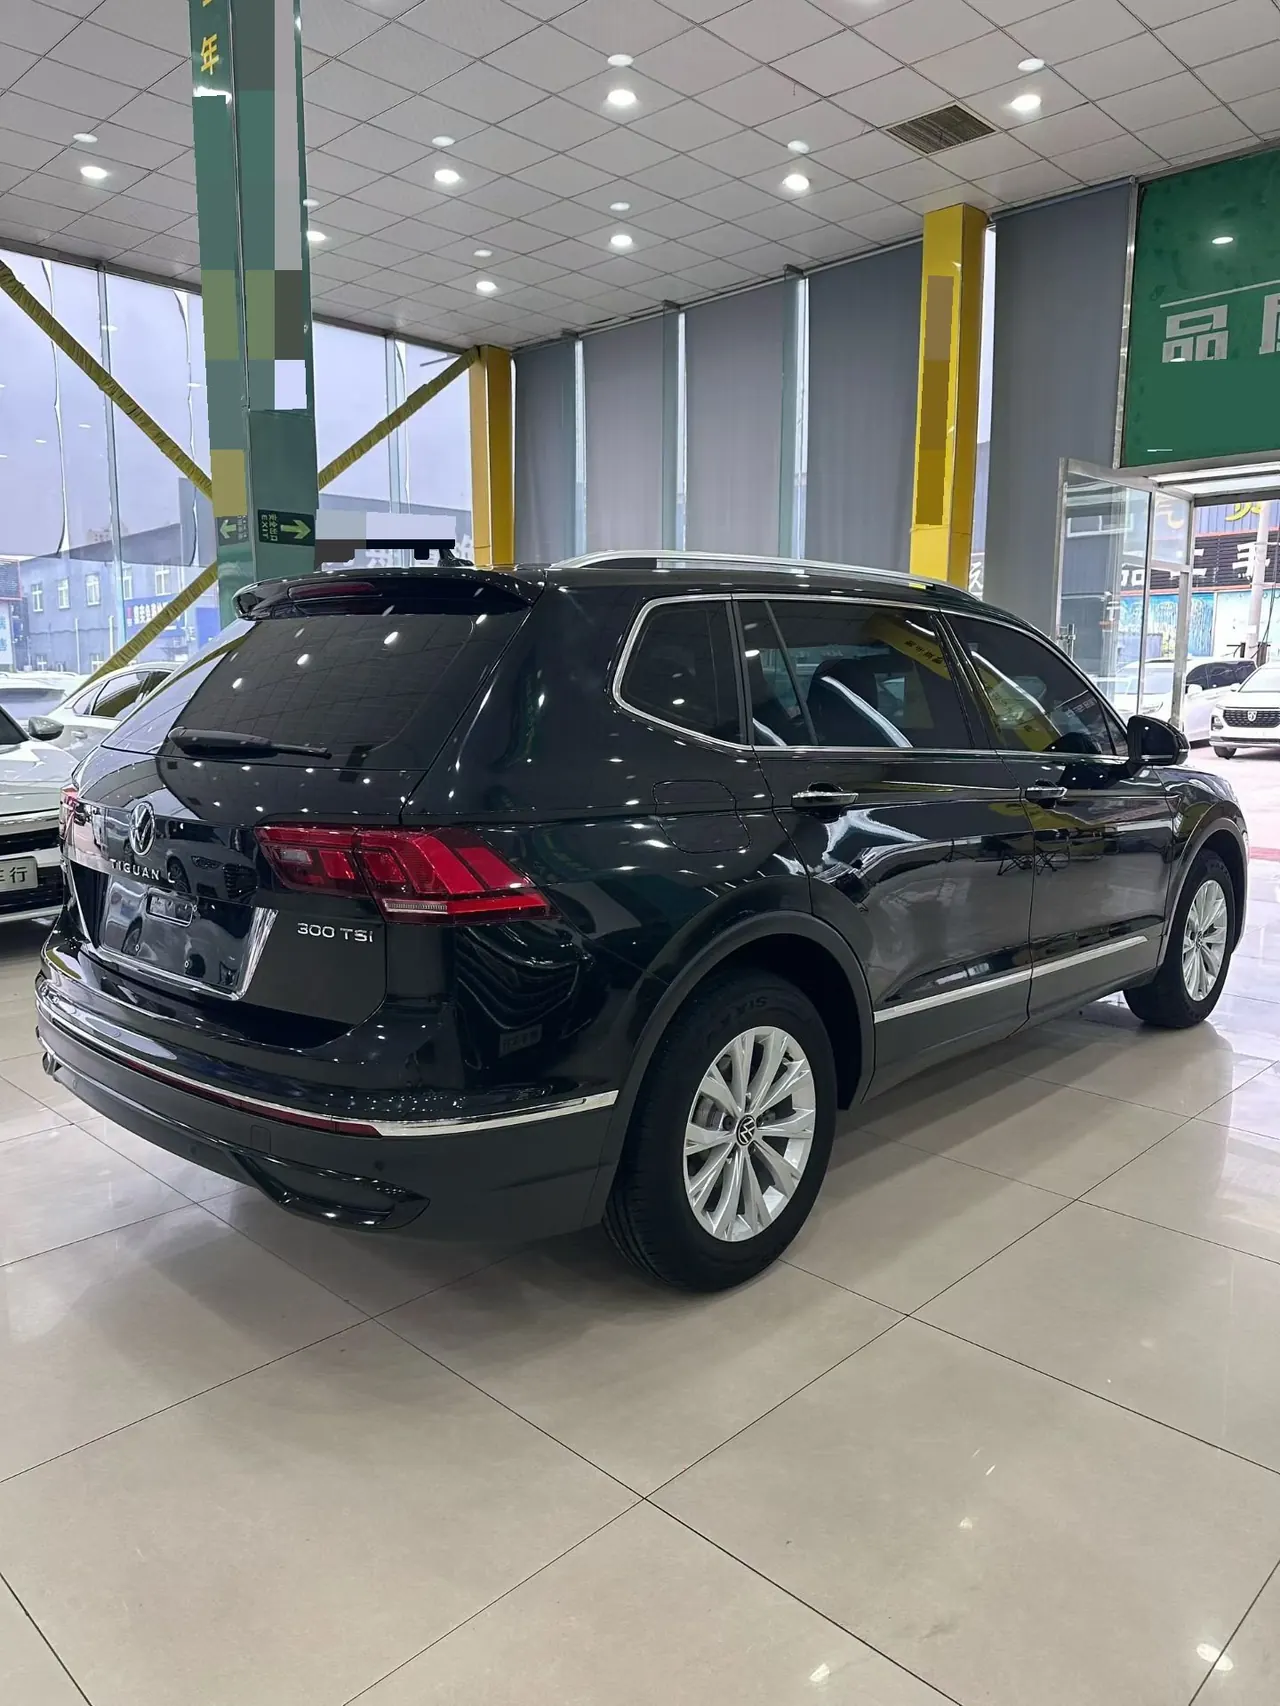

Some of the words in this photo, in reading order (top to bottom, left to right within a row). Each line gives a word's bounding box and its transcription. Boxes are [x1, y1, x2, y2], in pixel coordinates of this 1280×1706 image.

[261, 514, 269, 540] EXIT
[109, 858, 160, 881] TIGUAN
[167, 872, 176, 884] L
[297, 922, 335, 938] 300
